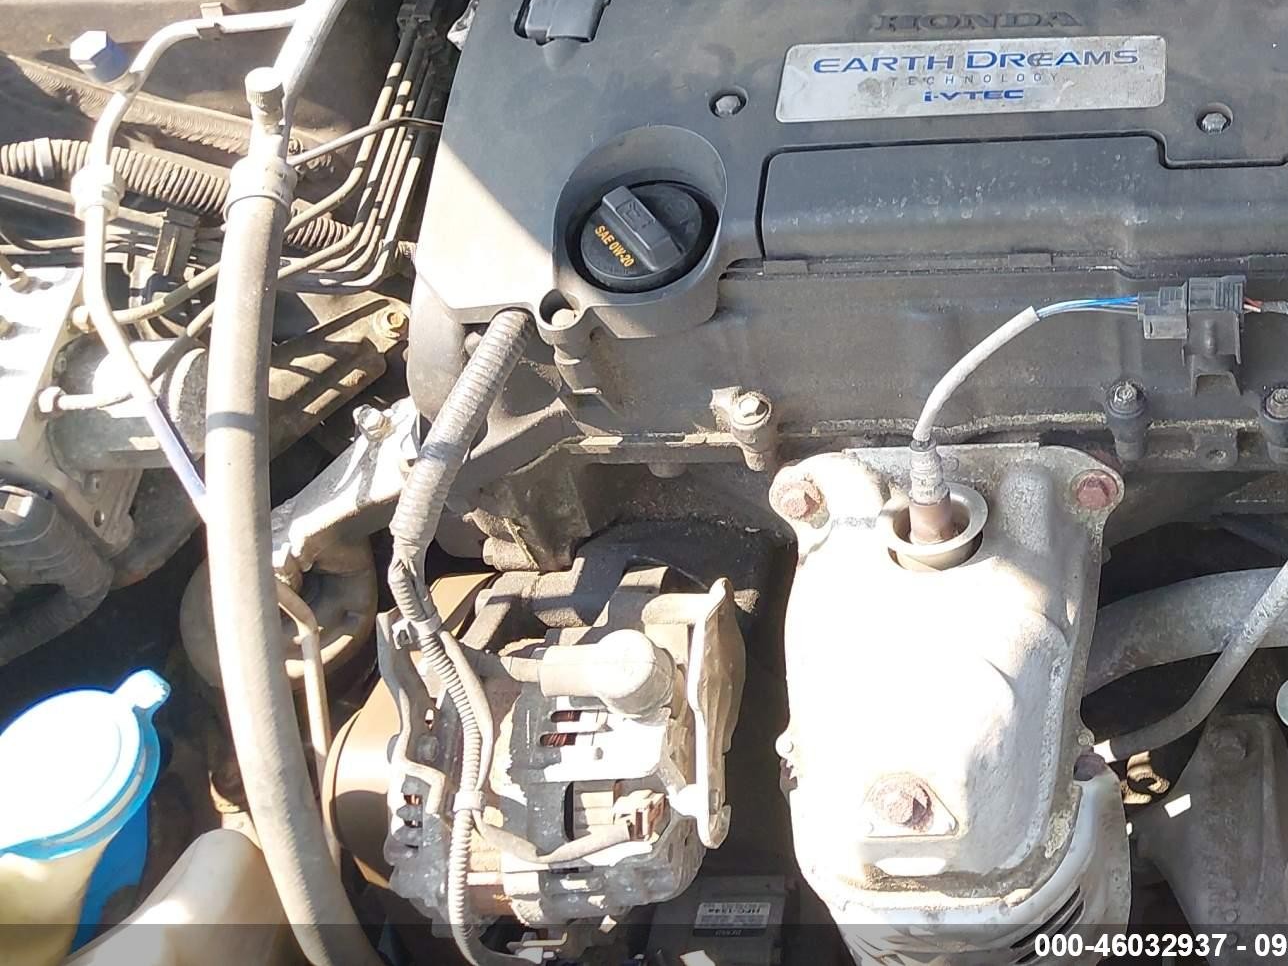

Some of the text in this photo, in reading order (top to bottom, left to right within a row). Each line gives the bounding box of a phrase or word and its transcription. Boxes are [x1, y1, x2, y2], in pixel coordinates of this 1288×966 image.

[874, 11, 1084, 32] HONDA
[813, 49, 1138, 74] EARTH DREAMS
[890, 72, 1059, 87] TECHNOLOGY
[595, 225, 635, 267] SAE 0W-20
